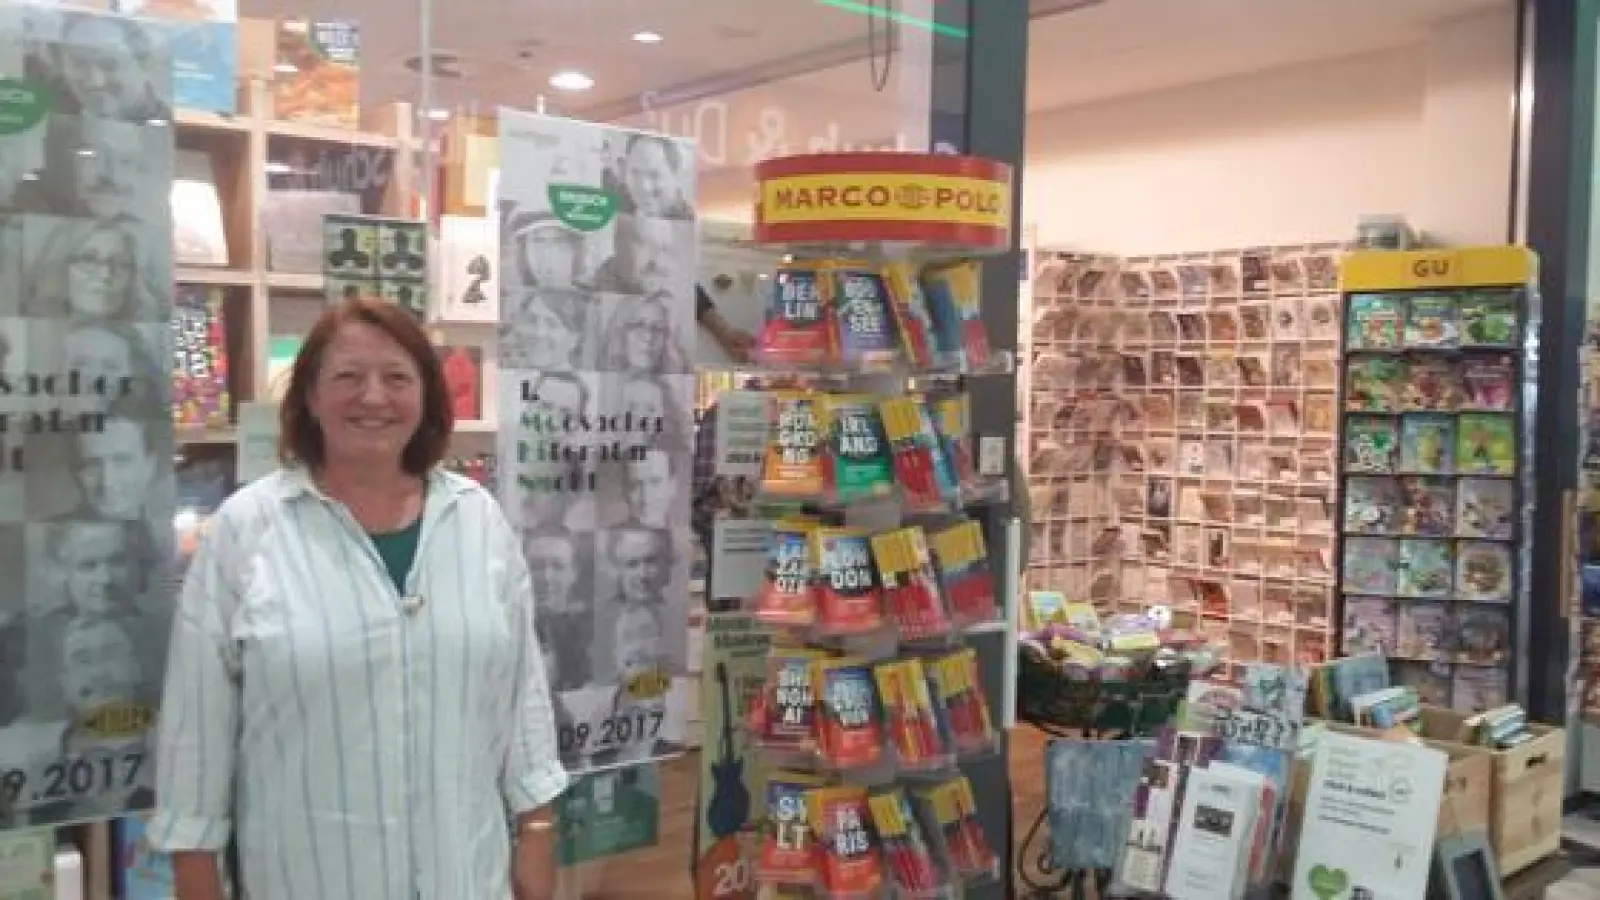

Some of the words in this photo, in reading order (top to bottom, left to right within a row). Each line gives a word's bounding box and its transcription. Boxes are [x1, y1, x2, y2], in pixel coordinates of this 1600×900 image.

[775, 184, 890, 209] MARCO
[1412, 259, 1450, 278] GU
[840, 435, 878, 454] AND
[831, 570, 872, 590] DON
[777, 822, 809, 850] LT
[836, 832, 869, 856] RIS
[712, 861, 748, 897] 20
